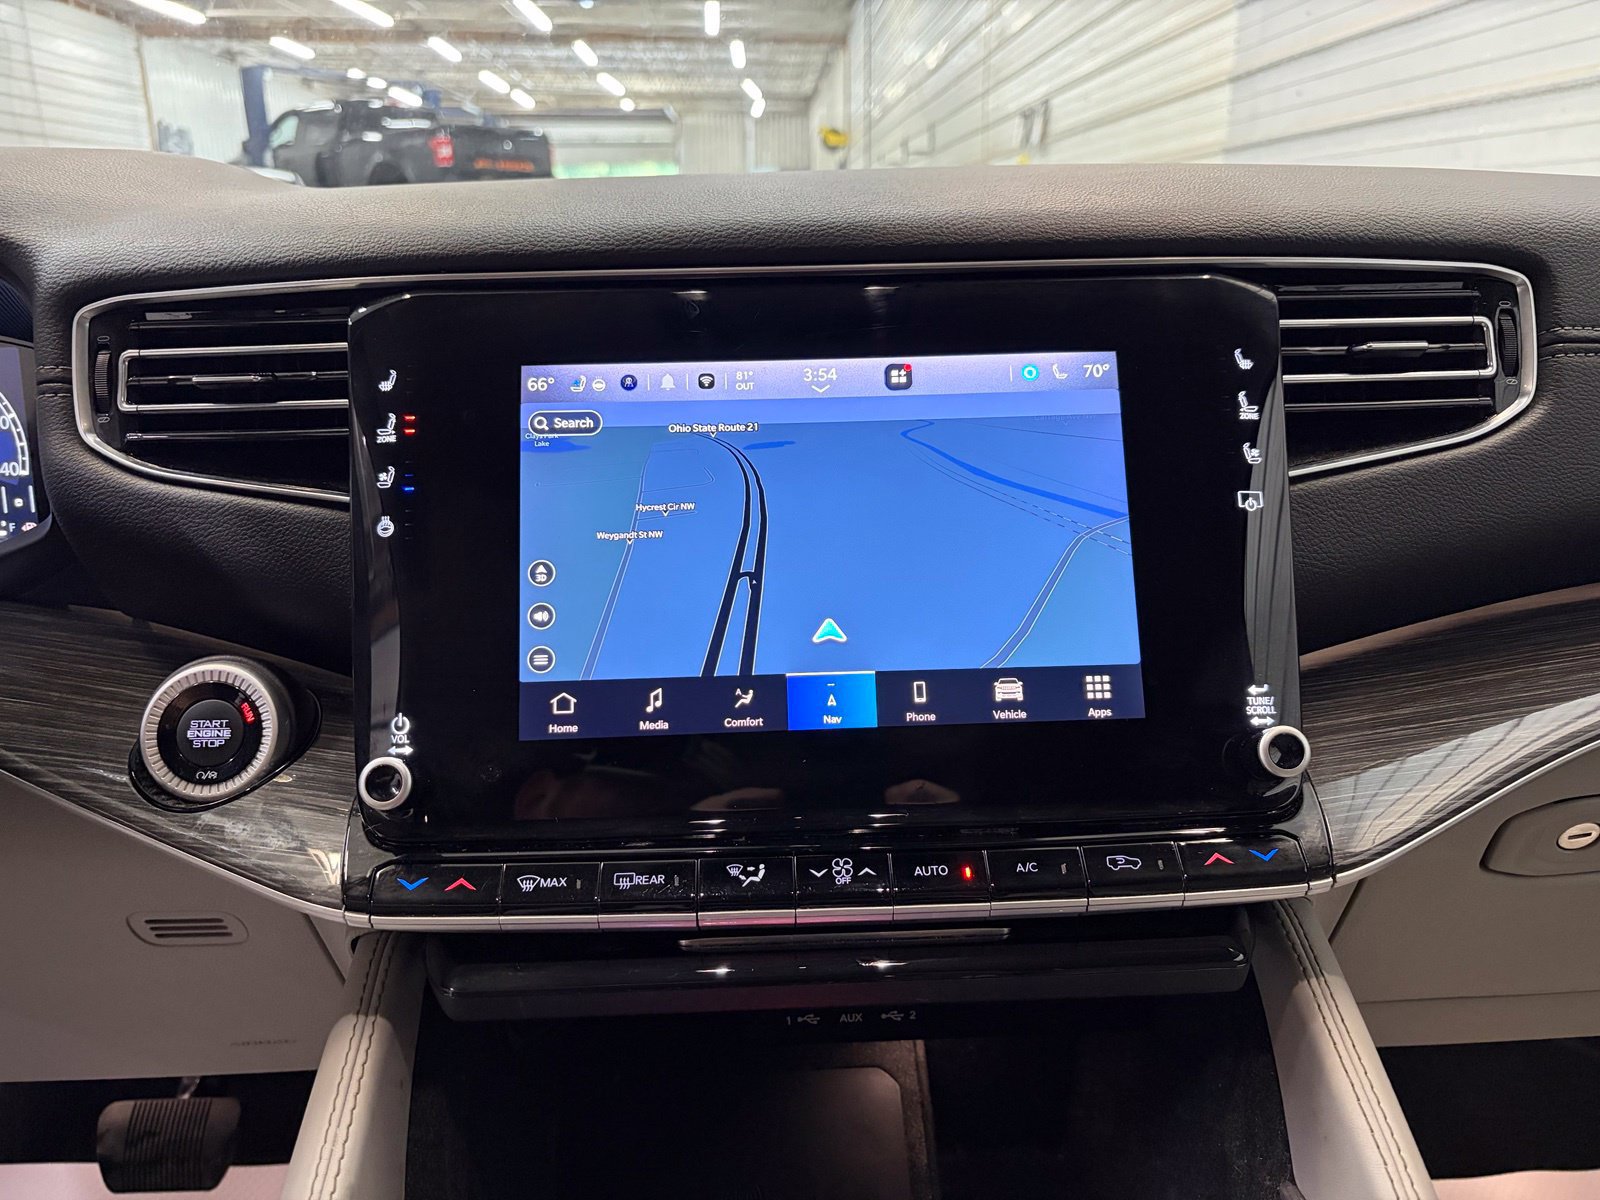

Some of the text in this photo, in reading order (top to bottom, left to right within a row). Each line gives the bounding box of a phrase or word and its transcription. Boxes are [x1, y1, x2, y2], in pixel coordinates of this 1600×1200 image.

[736, 371, 754, 380] 81°
[803, 368, 838, 382] 3:54
[1083, 363, 1111, 378] 70°
[527, 376, 555, 392] 66°
[736, 382, 754, 390] OUT
[554, 416, 594, 428] Search
[668, 422, 758, 432] Ohio State Route 21
[376, 435, 396, 443] ZONE
[636, 503, 666, 512] Hycrest
[668, 503, 680, 511] Cir
[596, 531, 638, 540] Weygandt
[638, 531, 648, 539] St
[1246, 696, 1274, 705] TUNE/
[241, 702, 255, 722] RUN
[993, 709, 1027, 720] Vehicle
[1088, 707, 1112, 719] Apps
[1246, 706, 1277, 715] SCROLL
[724, 717, 763, 727] Comfort
[823, 714, 842, 724] Nav
[906, 712, 936, 722] Phone
[548, 724, 578, 733] Home
[640, 720, 669, 730] Media
[187, 730, 232, 738] ENGINE
[391, 734, 410, 744] VOL
[192, 740, 225, 748] STOP
[914, 865, 948, 876] AUTO
[1016, 862, 1038, 873] A/C
[540, 877, 567, 888] MAX
[636, 875, 665, 885] REAR
[835, 877, 851, 885] OFF
[840, 1013, 863, 1023] AUX
[909, 1010, 916, 1020] 2
[786, 1016, 791, 1025] 1
